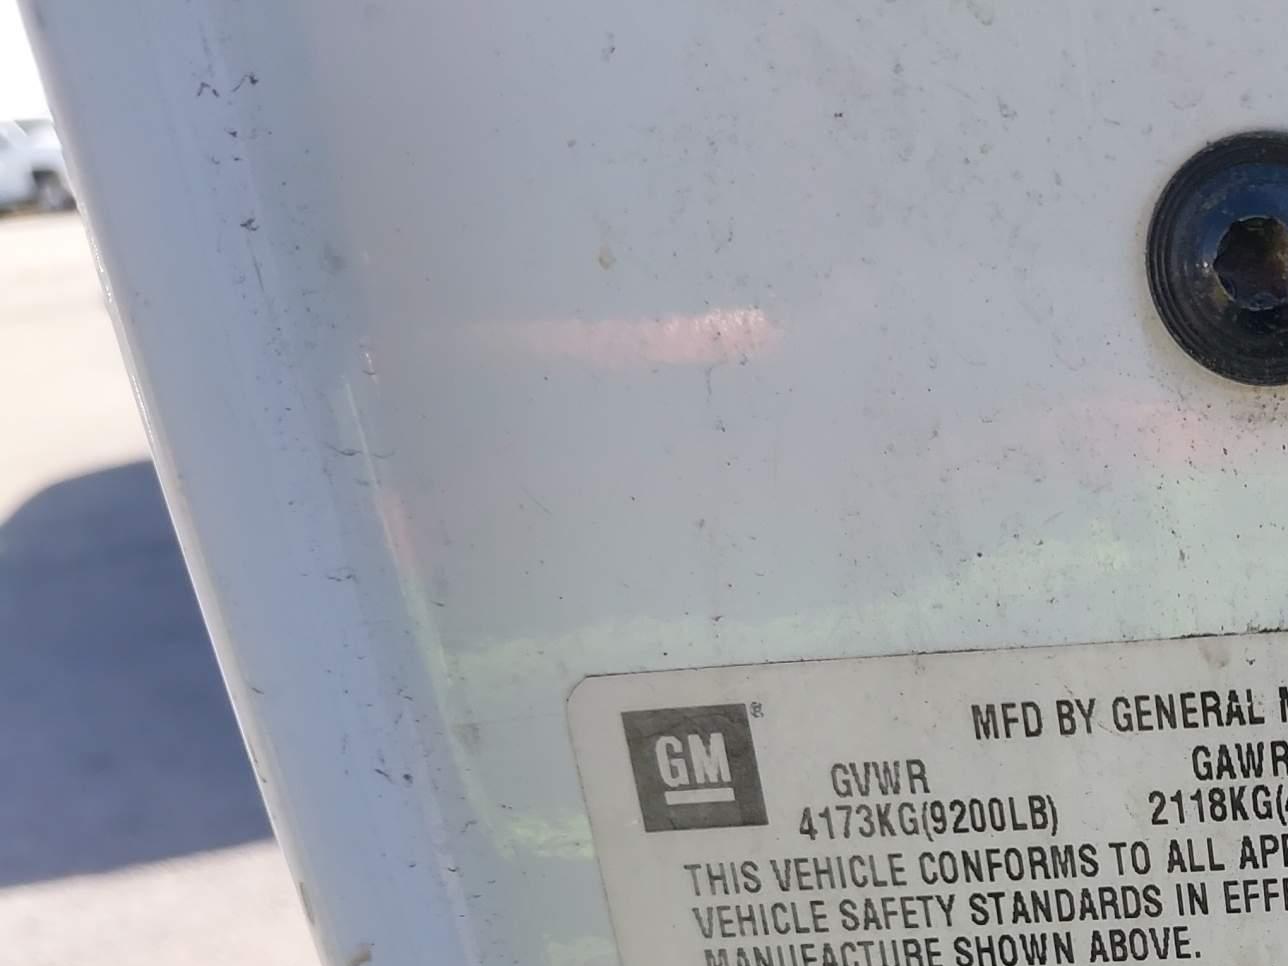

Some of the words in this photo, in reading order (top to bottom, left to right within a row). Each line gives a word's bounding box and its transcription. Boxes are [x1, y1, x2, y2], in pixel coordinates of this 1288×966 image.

[971, 701, 1042, 740] MFD
[1056, 698, 1095, 736] BY
[1112, 689, 1265, 732] GENERAL
[654, 732, 731, 788] GM
[831, 759, 930, 797] GVWR
[799, 795, 1058, 842] 4173KG(9200LB)
[683, 861, 761, 896] THIS
[770, 853, 907, 892] VEHICLE
[919, 844, 1099, 884] CONFORMS
[1108, 841, 1151, 875] TO
[1167, 838, 1225, 873] ALL
[692, 900, 829, 938] VEHICLE
[839, 894, 954, 931] SAFETY
[969, 884, 1162, 925] STANDARDS
[1176, 883, 1209, 916] IN
[1090, 926, 1201, 963] ABOVE.
